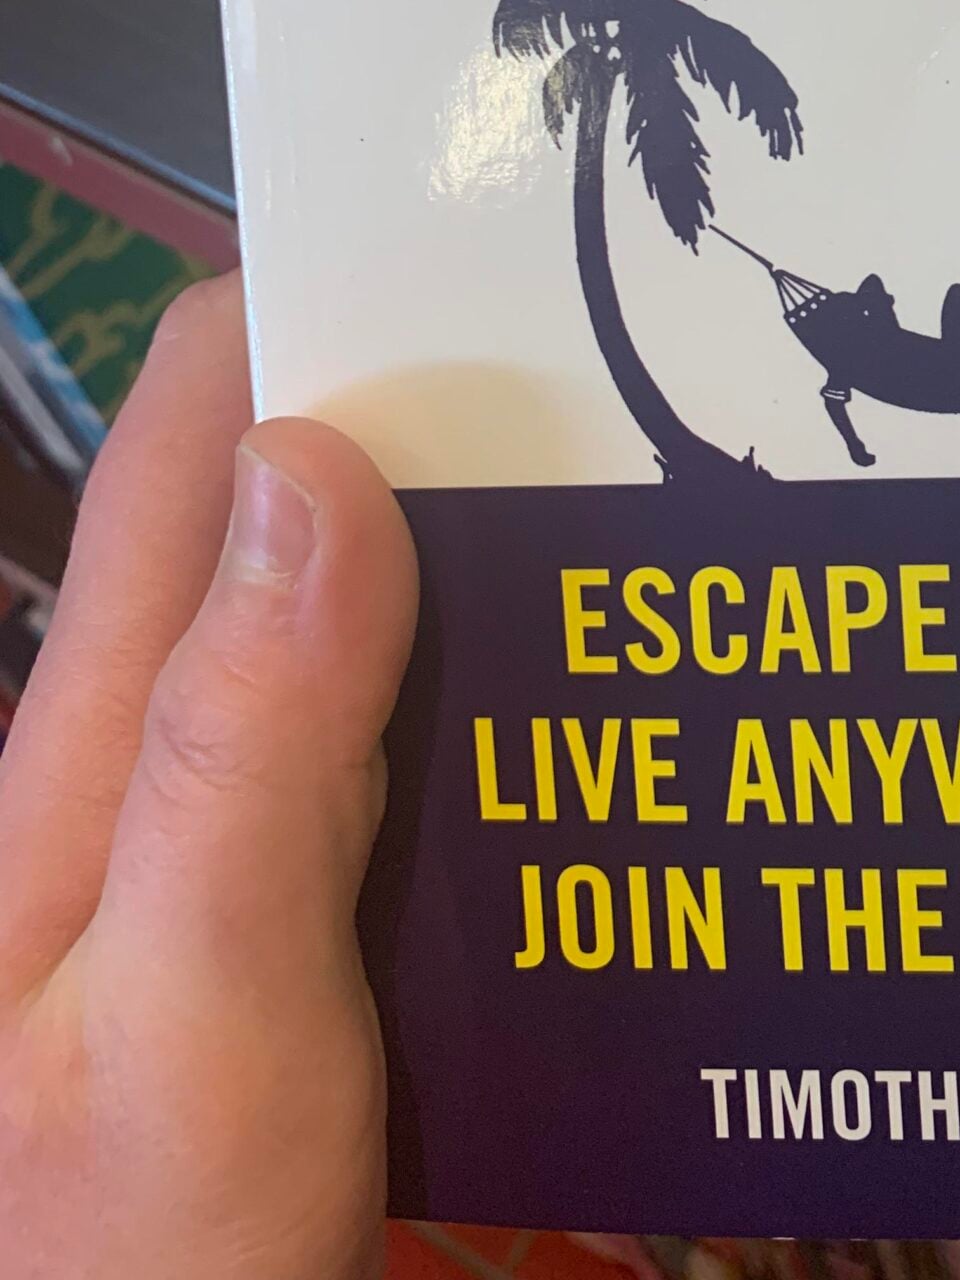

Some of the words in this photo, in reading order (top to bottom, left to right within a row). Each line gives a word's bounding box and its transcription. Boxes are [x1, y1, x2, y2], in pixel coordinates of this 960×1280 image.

[560, 563, 958, 675] ESCAPE
[473, 717, 688, 823] LIVE
[514, 864, 727, 971] JOIN
[761, 868, 955, 973] THE
